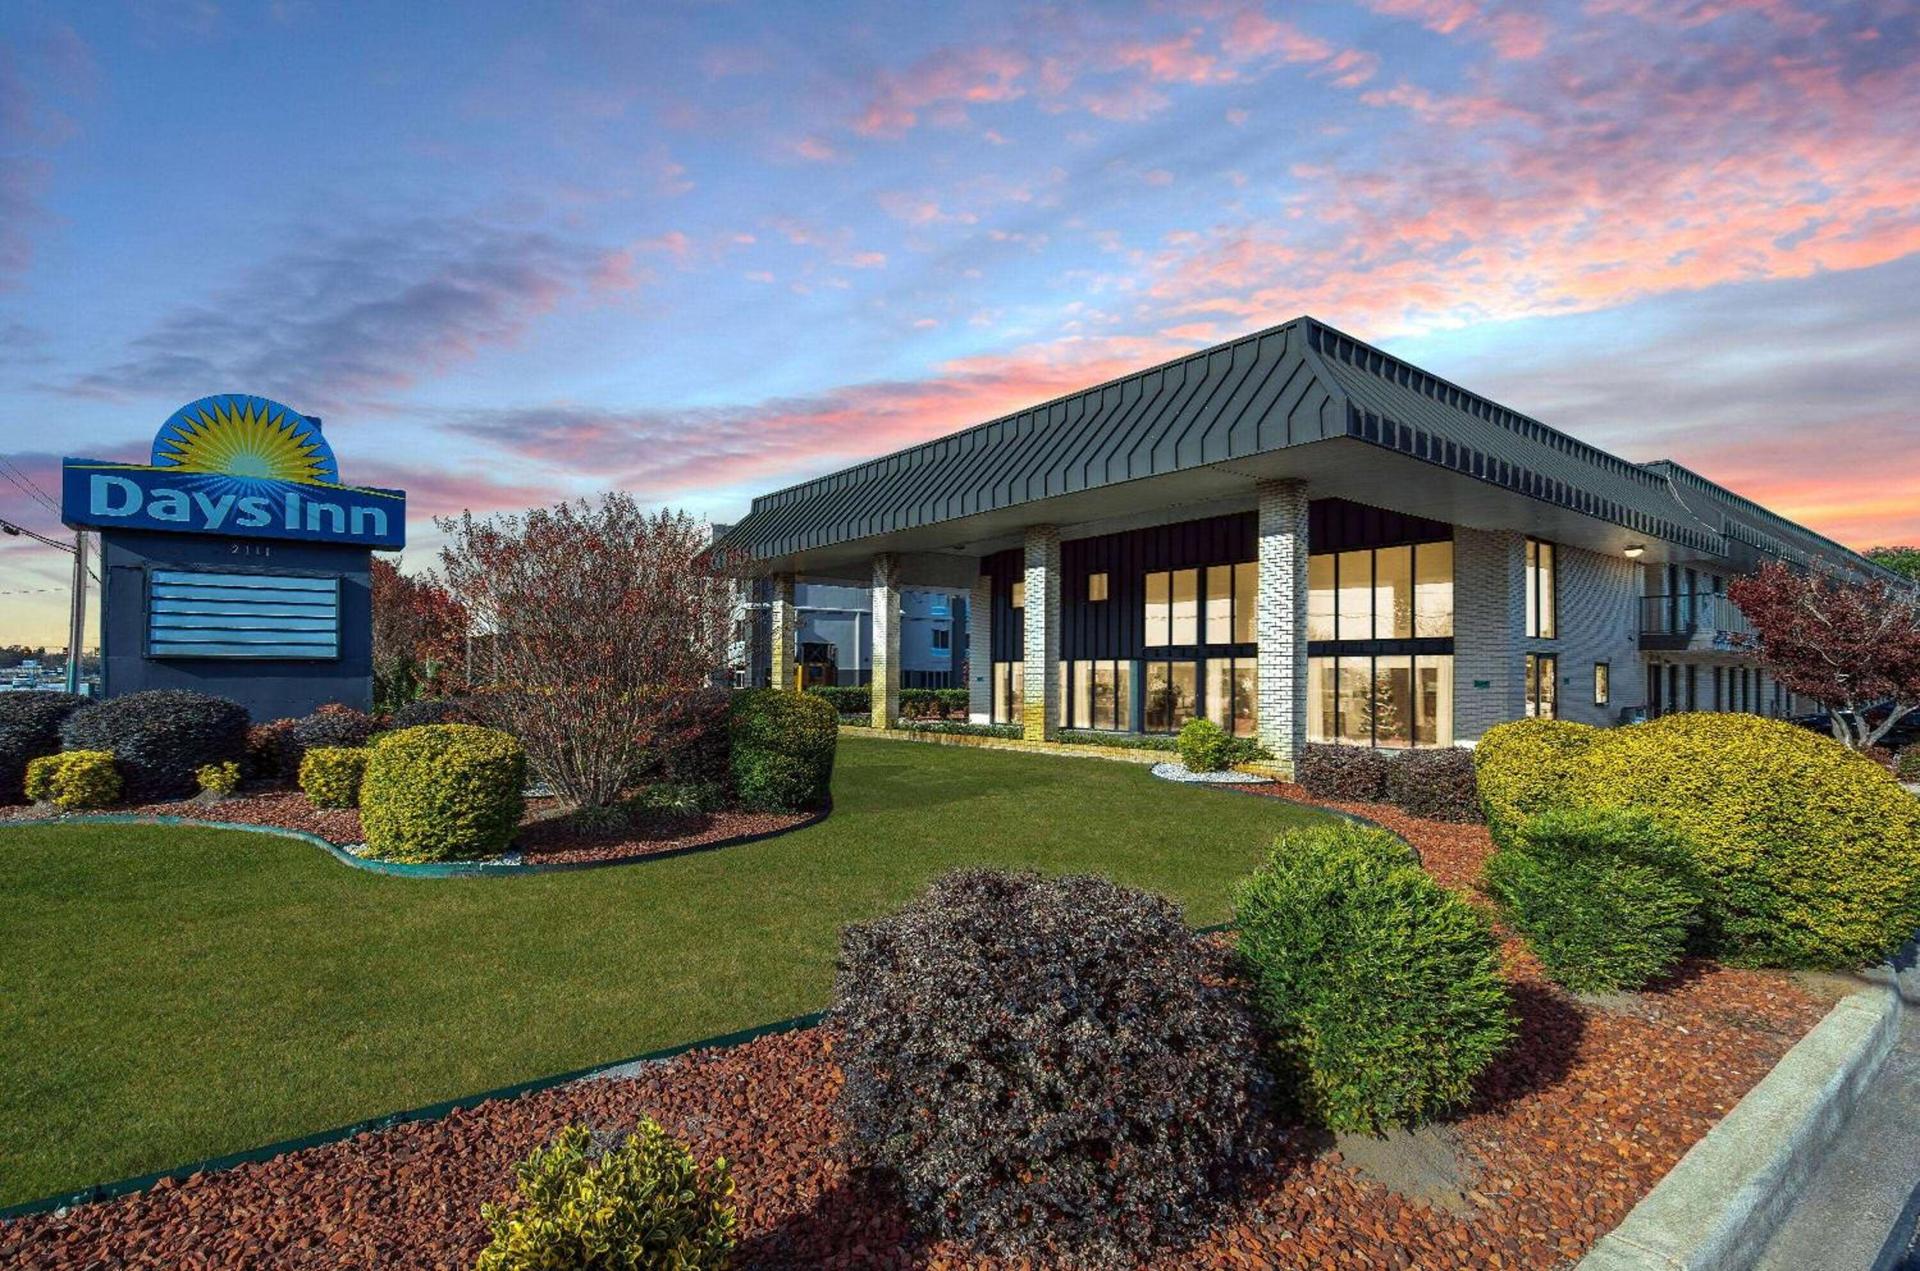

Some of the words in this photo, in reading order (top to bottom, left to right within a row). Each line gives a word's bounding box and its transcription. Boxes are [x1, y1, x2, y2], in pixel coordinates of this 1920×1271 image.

[90, 474, 272, 530] Days
[284, 492, 388, 536] Inn
[231, 544, 270, 557] 2111
